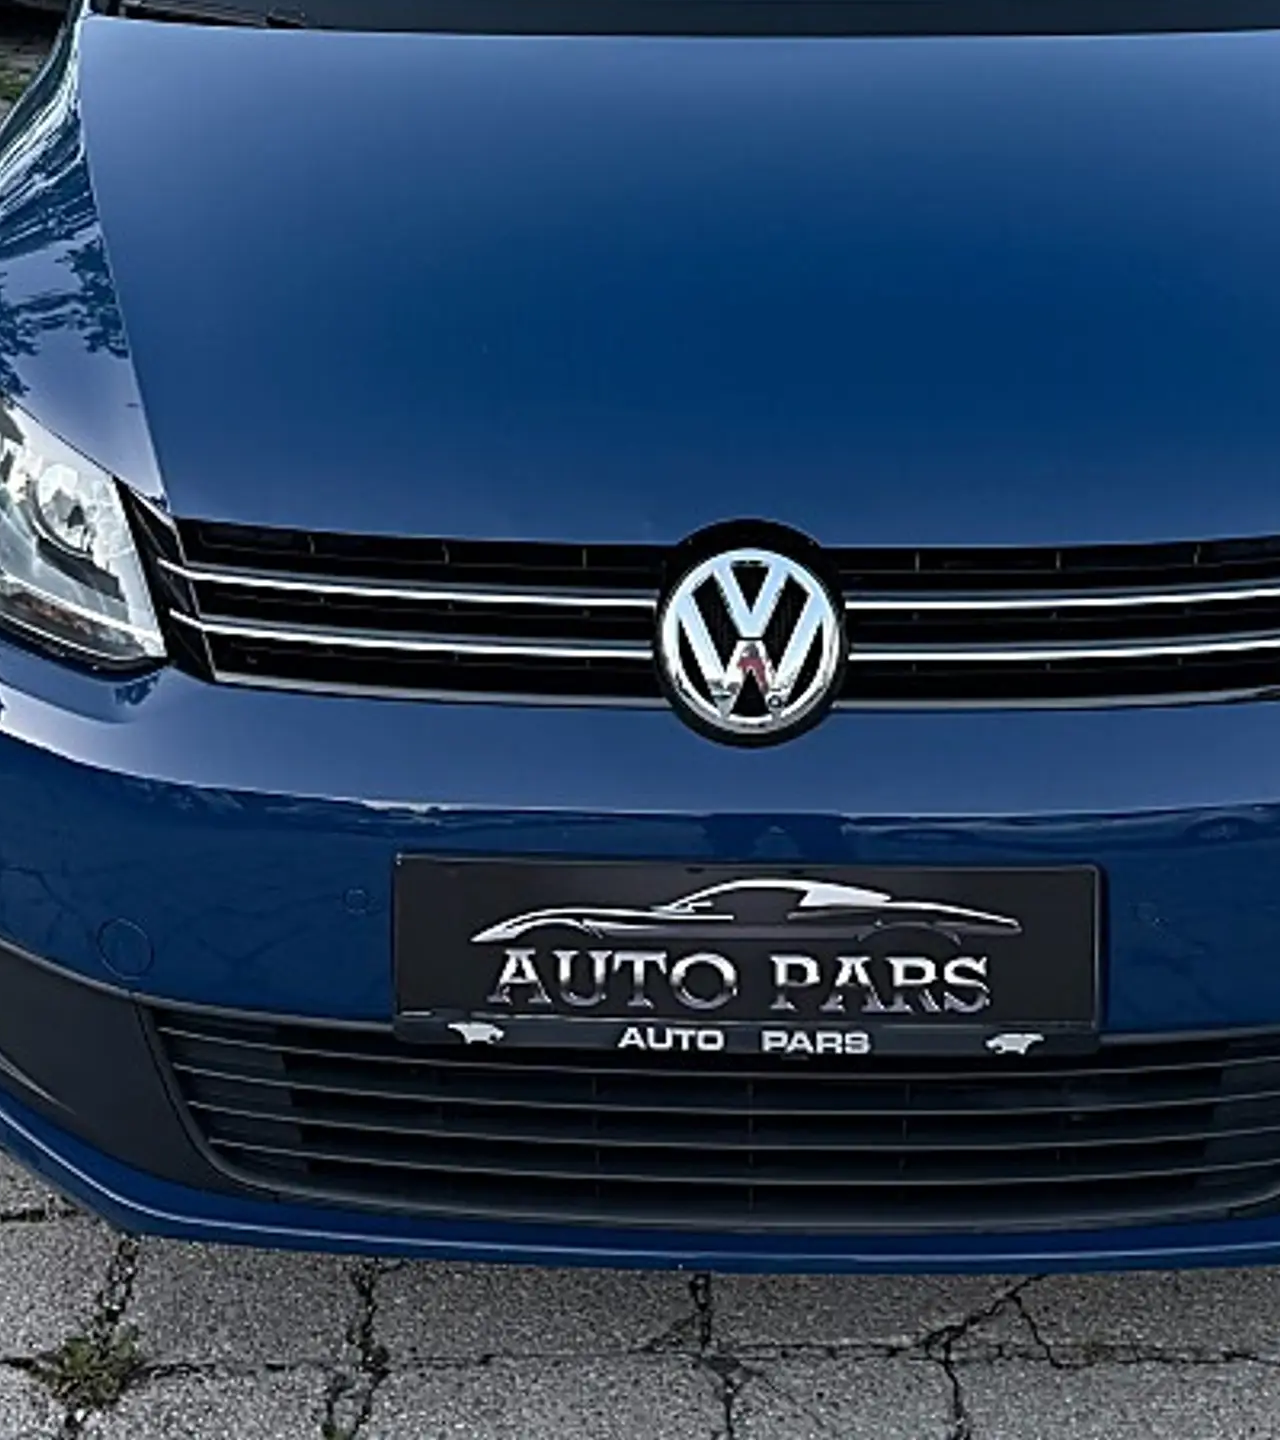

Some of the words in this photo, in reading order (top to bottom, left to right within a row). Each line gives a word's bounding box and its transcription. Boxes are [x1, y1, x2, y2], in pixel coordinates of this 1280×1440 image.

[486, 948, 739, 1011] AUTO
[769, 955, 992, 1015] PARS
[617, 1025, 724, 1053] AUTO
[761, 1030, 872, 1056] PARS
